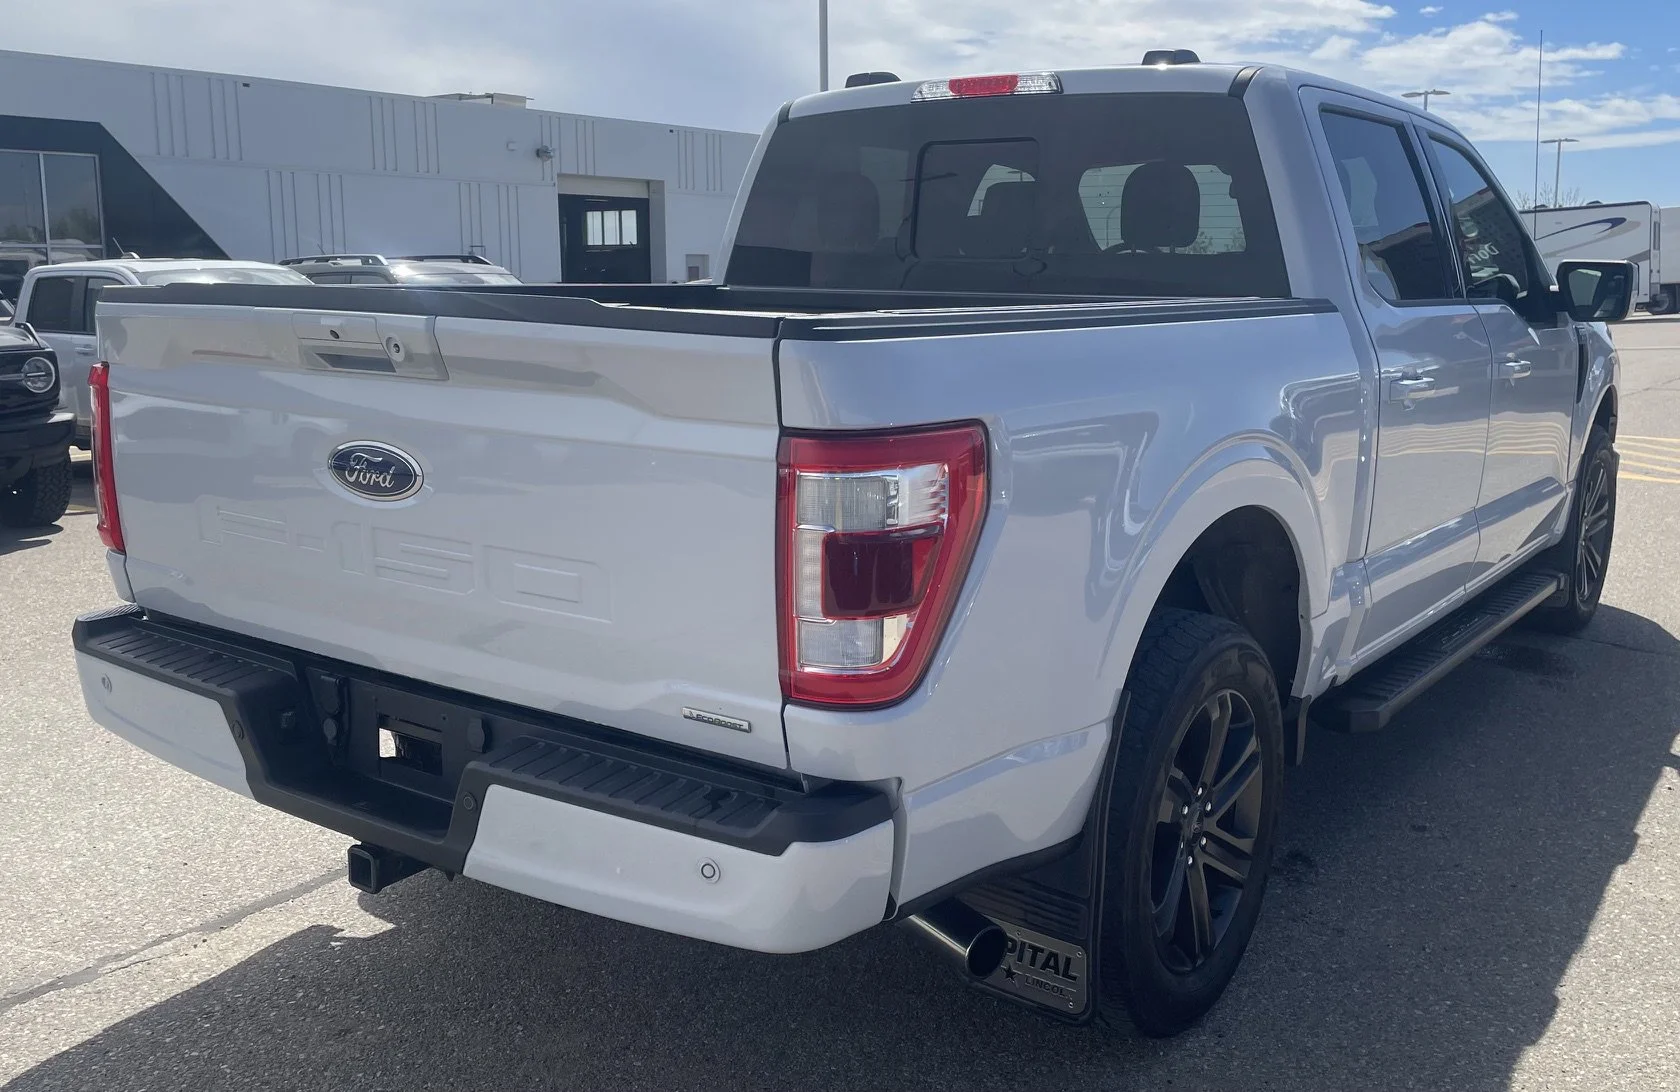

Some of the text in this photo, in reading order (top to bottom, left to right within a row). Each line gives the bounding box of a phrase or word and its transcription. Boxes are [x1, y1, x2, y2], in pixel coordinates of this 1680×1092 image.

[345, 452, 395, 488] Ford
[195, 496, 614, 624] F-150
[1005, 934, 1078, 982] PITAL
